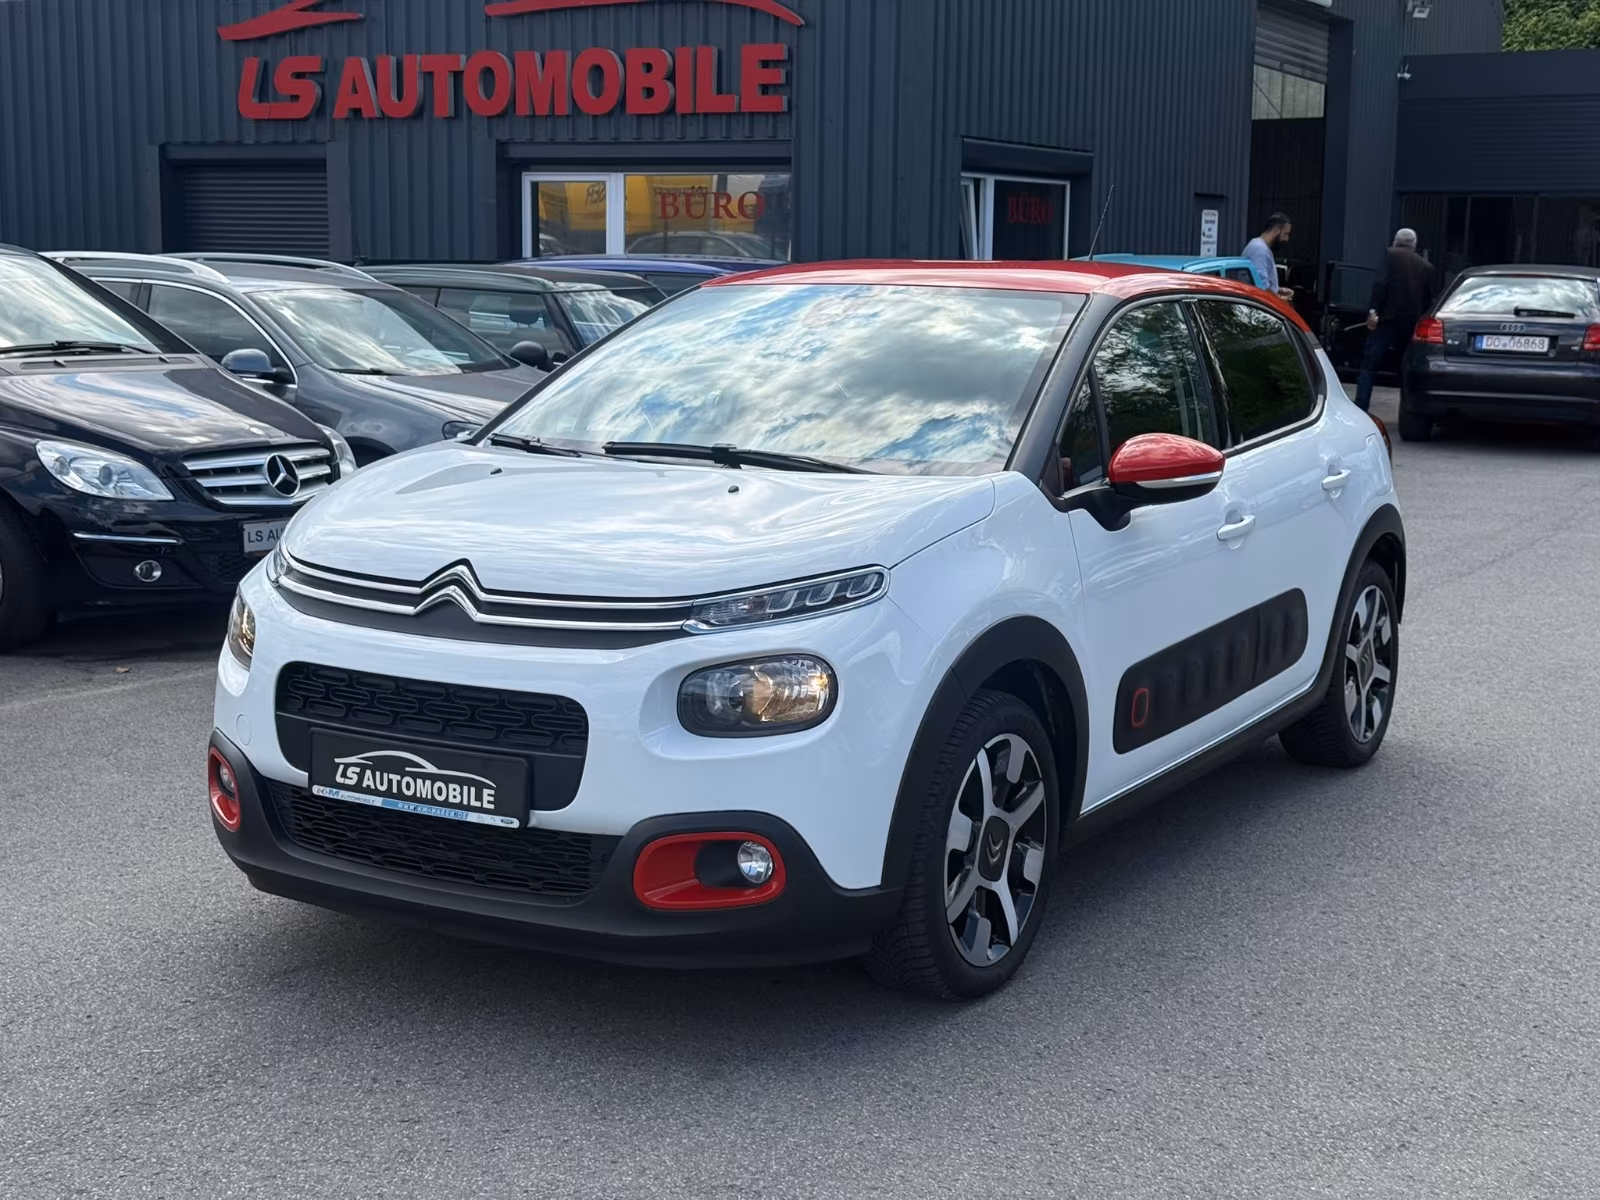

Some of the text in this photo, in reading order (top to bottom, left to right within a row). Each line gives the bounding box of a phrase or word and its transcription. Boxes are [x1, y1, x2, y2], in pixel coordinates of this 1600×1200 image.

[237, 43, 789, 120] LS AUTOMOBILE
[657, 186, 766, 220] BÜRO
[247, 530, 264, 544] LS
[335, 764, 495, 810] LS AUTOMOBILE
